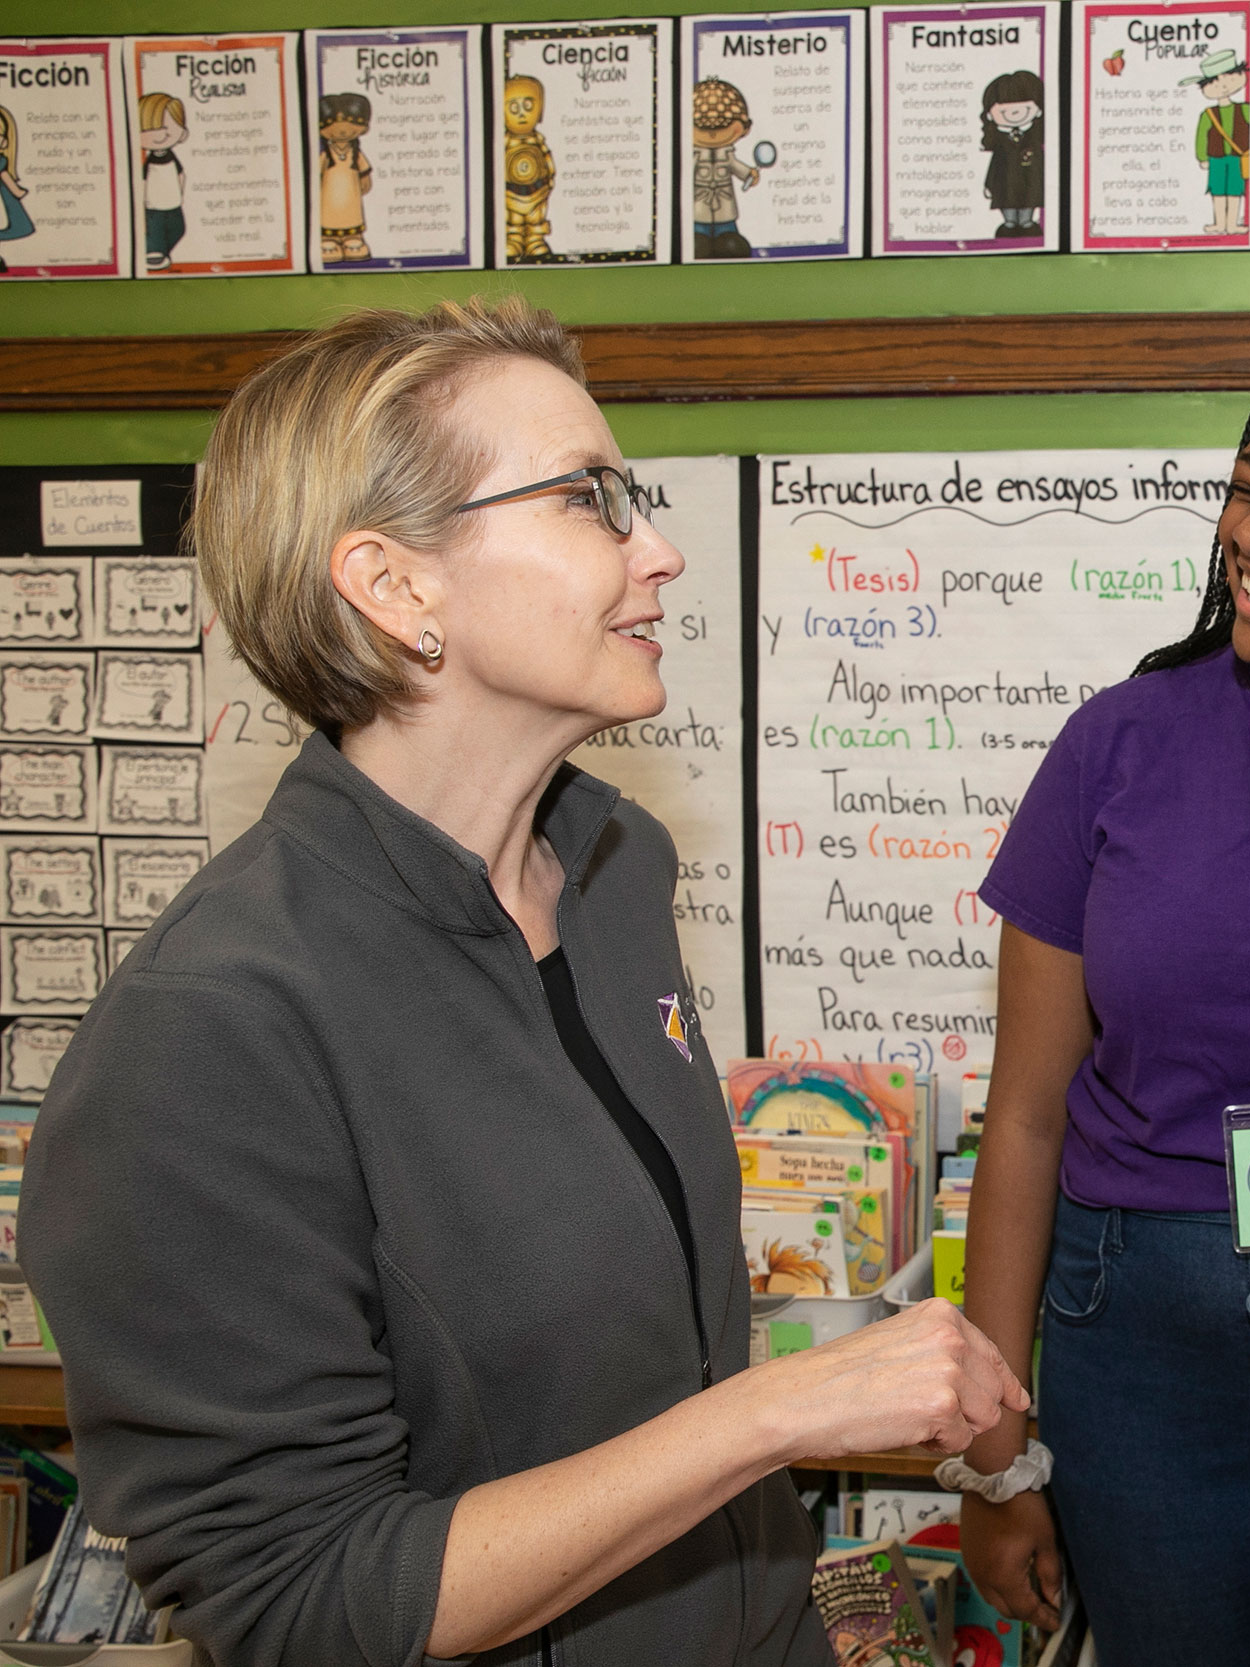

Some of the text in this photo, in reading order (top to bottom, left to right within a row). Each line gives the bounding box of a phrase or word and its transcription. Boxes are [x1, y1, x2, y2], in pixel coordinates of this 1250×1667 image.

[1128, 18, 1219, 43] Cuento
[542, 42, 628, 65] Ciencia
[723, 33, 827, 56] Misterio
[176, 55, 256, 79] Ficción
[357, 45, 438, 71] Ficción
[905, 62, 965, 73] Narración
[896, 80, 973, 94] que contiene
[902, 98, 967, 109] elementos
[903, 115, 967, 128] imposibles
[898, 134, 972, 147] como magia
[900, 188, 970, 202] imaginarios
[899, 205, 971, 219] que pueden
[51, 487, 130, 510] Elementos
[772, 461, 931, 505] Estructura
[942, 461, 983, 503] de
[997, 475, 1118, 514] ensayos
[47, 516, 135, 536] de Cuentos
[827, 549, 919, 592] (Tesis)
[942, 568, 1043, 607] porque
[1071, 558, 1163, 591] (razón
[762, 604, 943, 655] y (razón 3).
[827, 660, 1068, 719] Algo importante
[764, 725, 799, 749] es
[810, 716, 910, 750] (razón
[925, 716, 962, 751] 1).
[822, 769, 946, 815] También
[766, 821, 804, 858] (T)
[819, 835, 857, 859] es
[868, 824, 971, 859] (razón
[826, 879, 933, 940] Aunque
[765, 934, 993, 983] más que nada
[818, 987, 882, 1031] Para
[779, 1154, 806, 1171] Sopa
